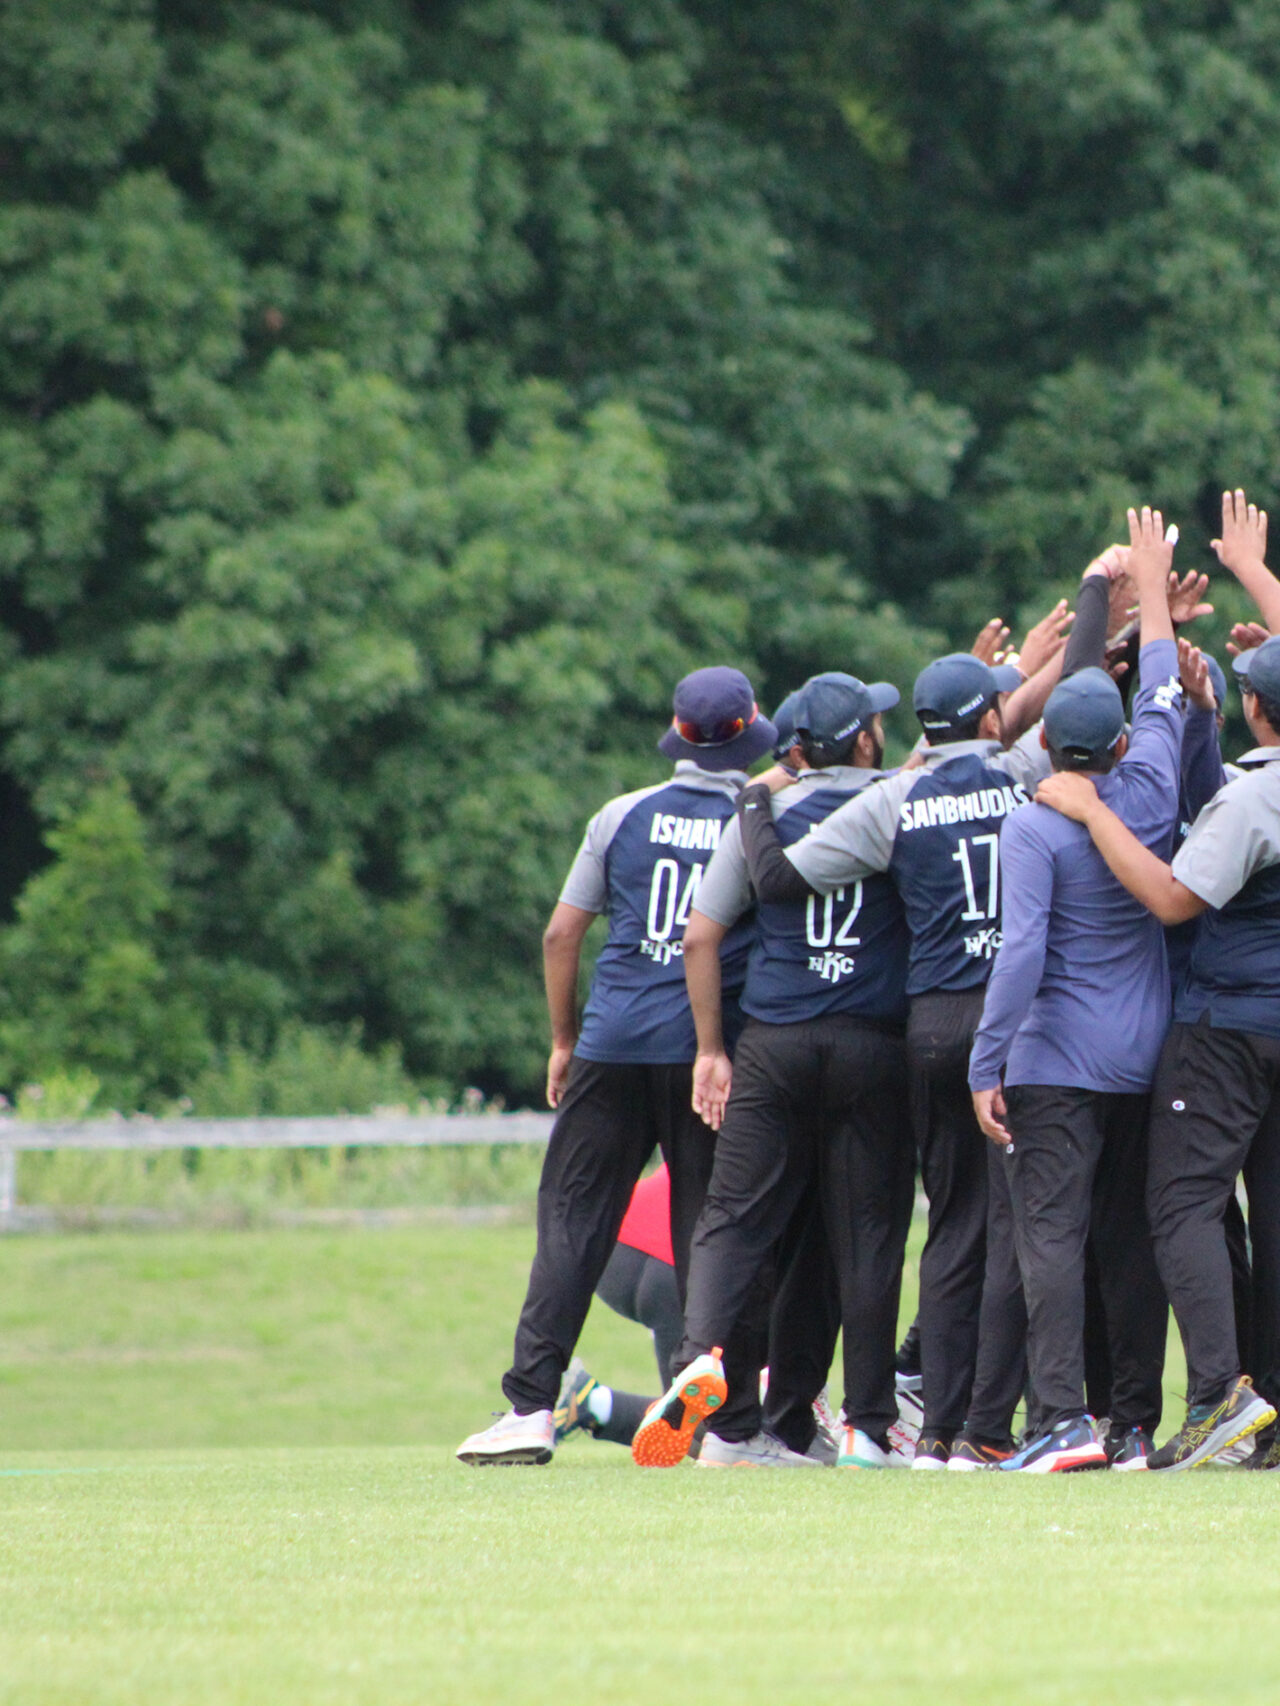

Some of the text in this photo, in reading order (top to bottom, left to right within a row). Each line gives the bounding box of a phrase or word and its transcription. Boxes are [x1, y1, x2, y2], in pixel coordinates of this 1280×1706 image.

[650, 812, 721, 850] ISHAN
[901, 783, 1029, 831] SAMBHUDAS
[952, 833, 998, 921] 17
[806, 878, 863, 948] 02
